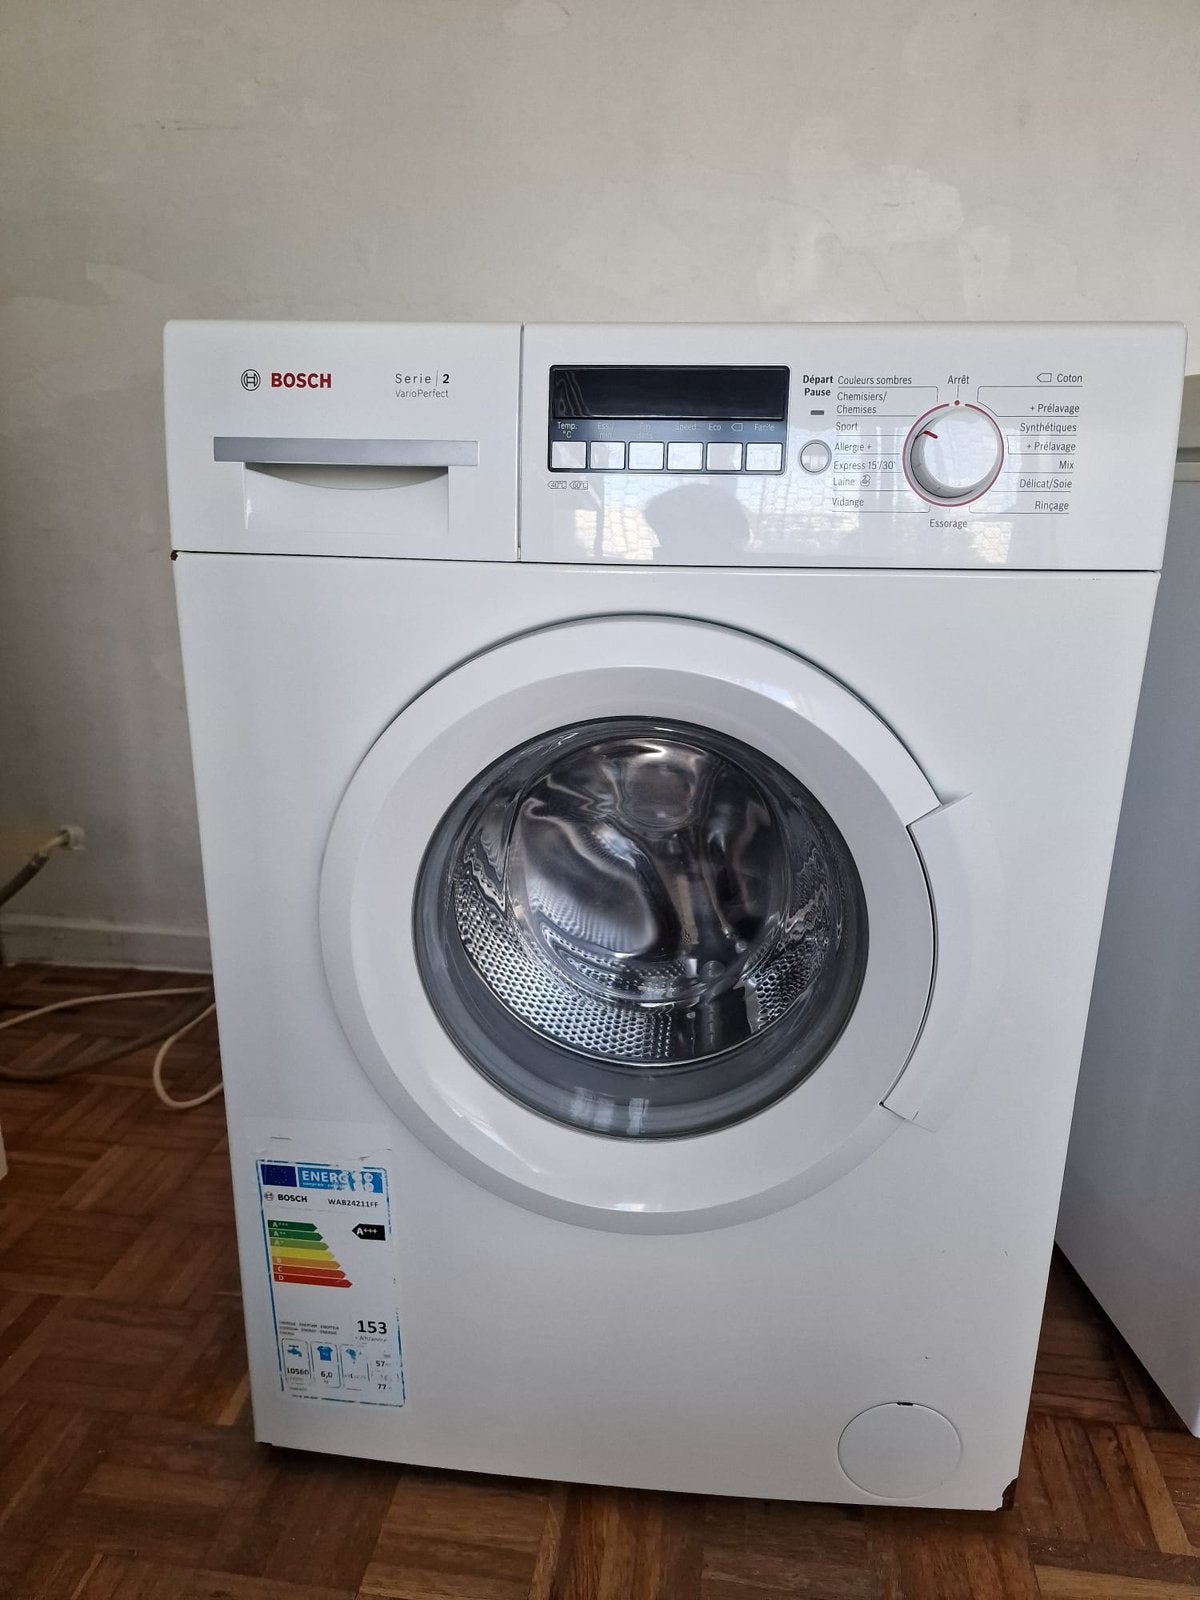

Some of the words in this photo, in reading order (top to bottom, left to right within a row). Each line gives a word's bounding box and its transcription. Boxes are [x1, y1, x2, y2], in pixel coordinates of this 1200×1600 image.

[271, 372, 332, 388] BOSCH
[395, 373, 431, 384] Serie
[442, 373, 450, 384] 2
[803, 375, 834, 385] Départ
[837, 376, 874, 385] Couleurs
[876, 375, 912, 385] sombres
[947, 374, 970, 385] Arrêt
[1056, 373, 1083, 383] Coton
[395, 389, 449, 398] VarioPerfect
[804, 387, 831, 396] Pause
[837, 391, 888, 402] Chemisiers/
[836, 404, 877, 414] Chemises
[1037, 403, 1080, 415] Prélavage
[557, 421, 578, 431] Temp.
[708, 423, 722, 431] Eco
[835, 421, 858, 432] Sport
[1020, 422, 1077, 434] Synthétiques
[562, 430, 572, 439] °C
[834, 442, 864, 453] Allergie
[1034, 441, 1076, 453] Prélavage
[833, 461, 866, 471] Express
[1059, 460, 1074, 469] Mix
[833, 477, 856, 486] Laine
[1019, 478, 1073, 490] Délicat/Soie
[831, 497, 864, 508] Vidange
[1034, 500, 1069, 512] Rinçage
[929, 518, 968, 529] Essorage
[277, 1193, 308, 1203] BOSCH
[356, 1227, 378, 1236] A+++
[357, 1320, 388, 1335] 153
